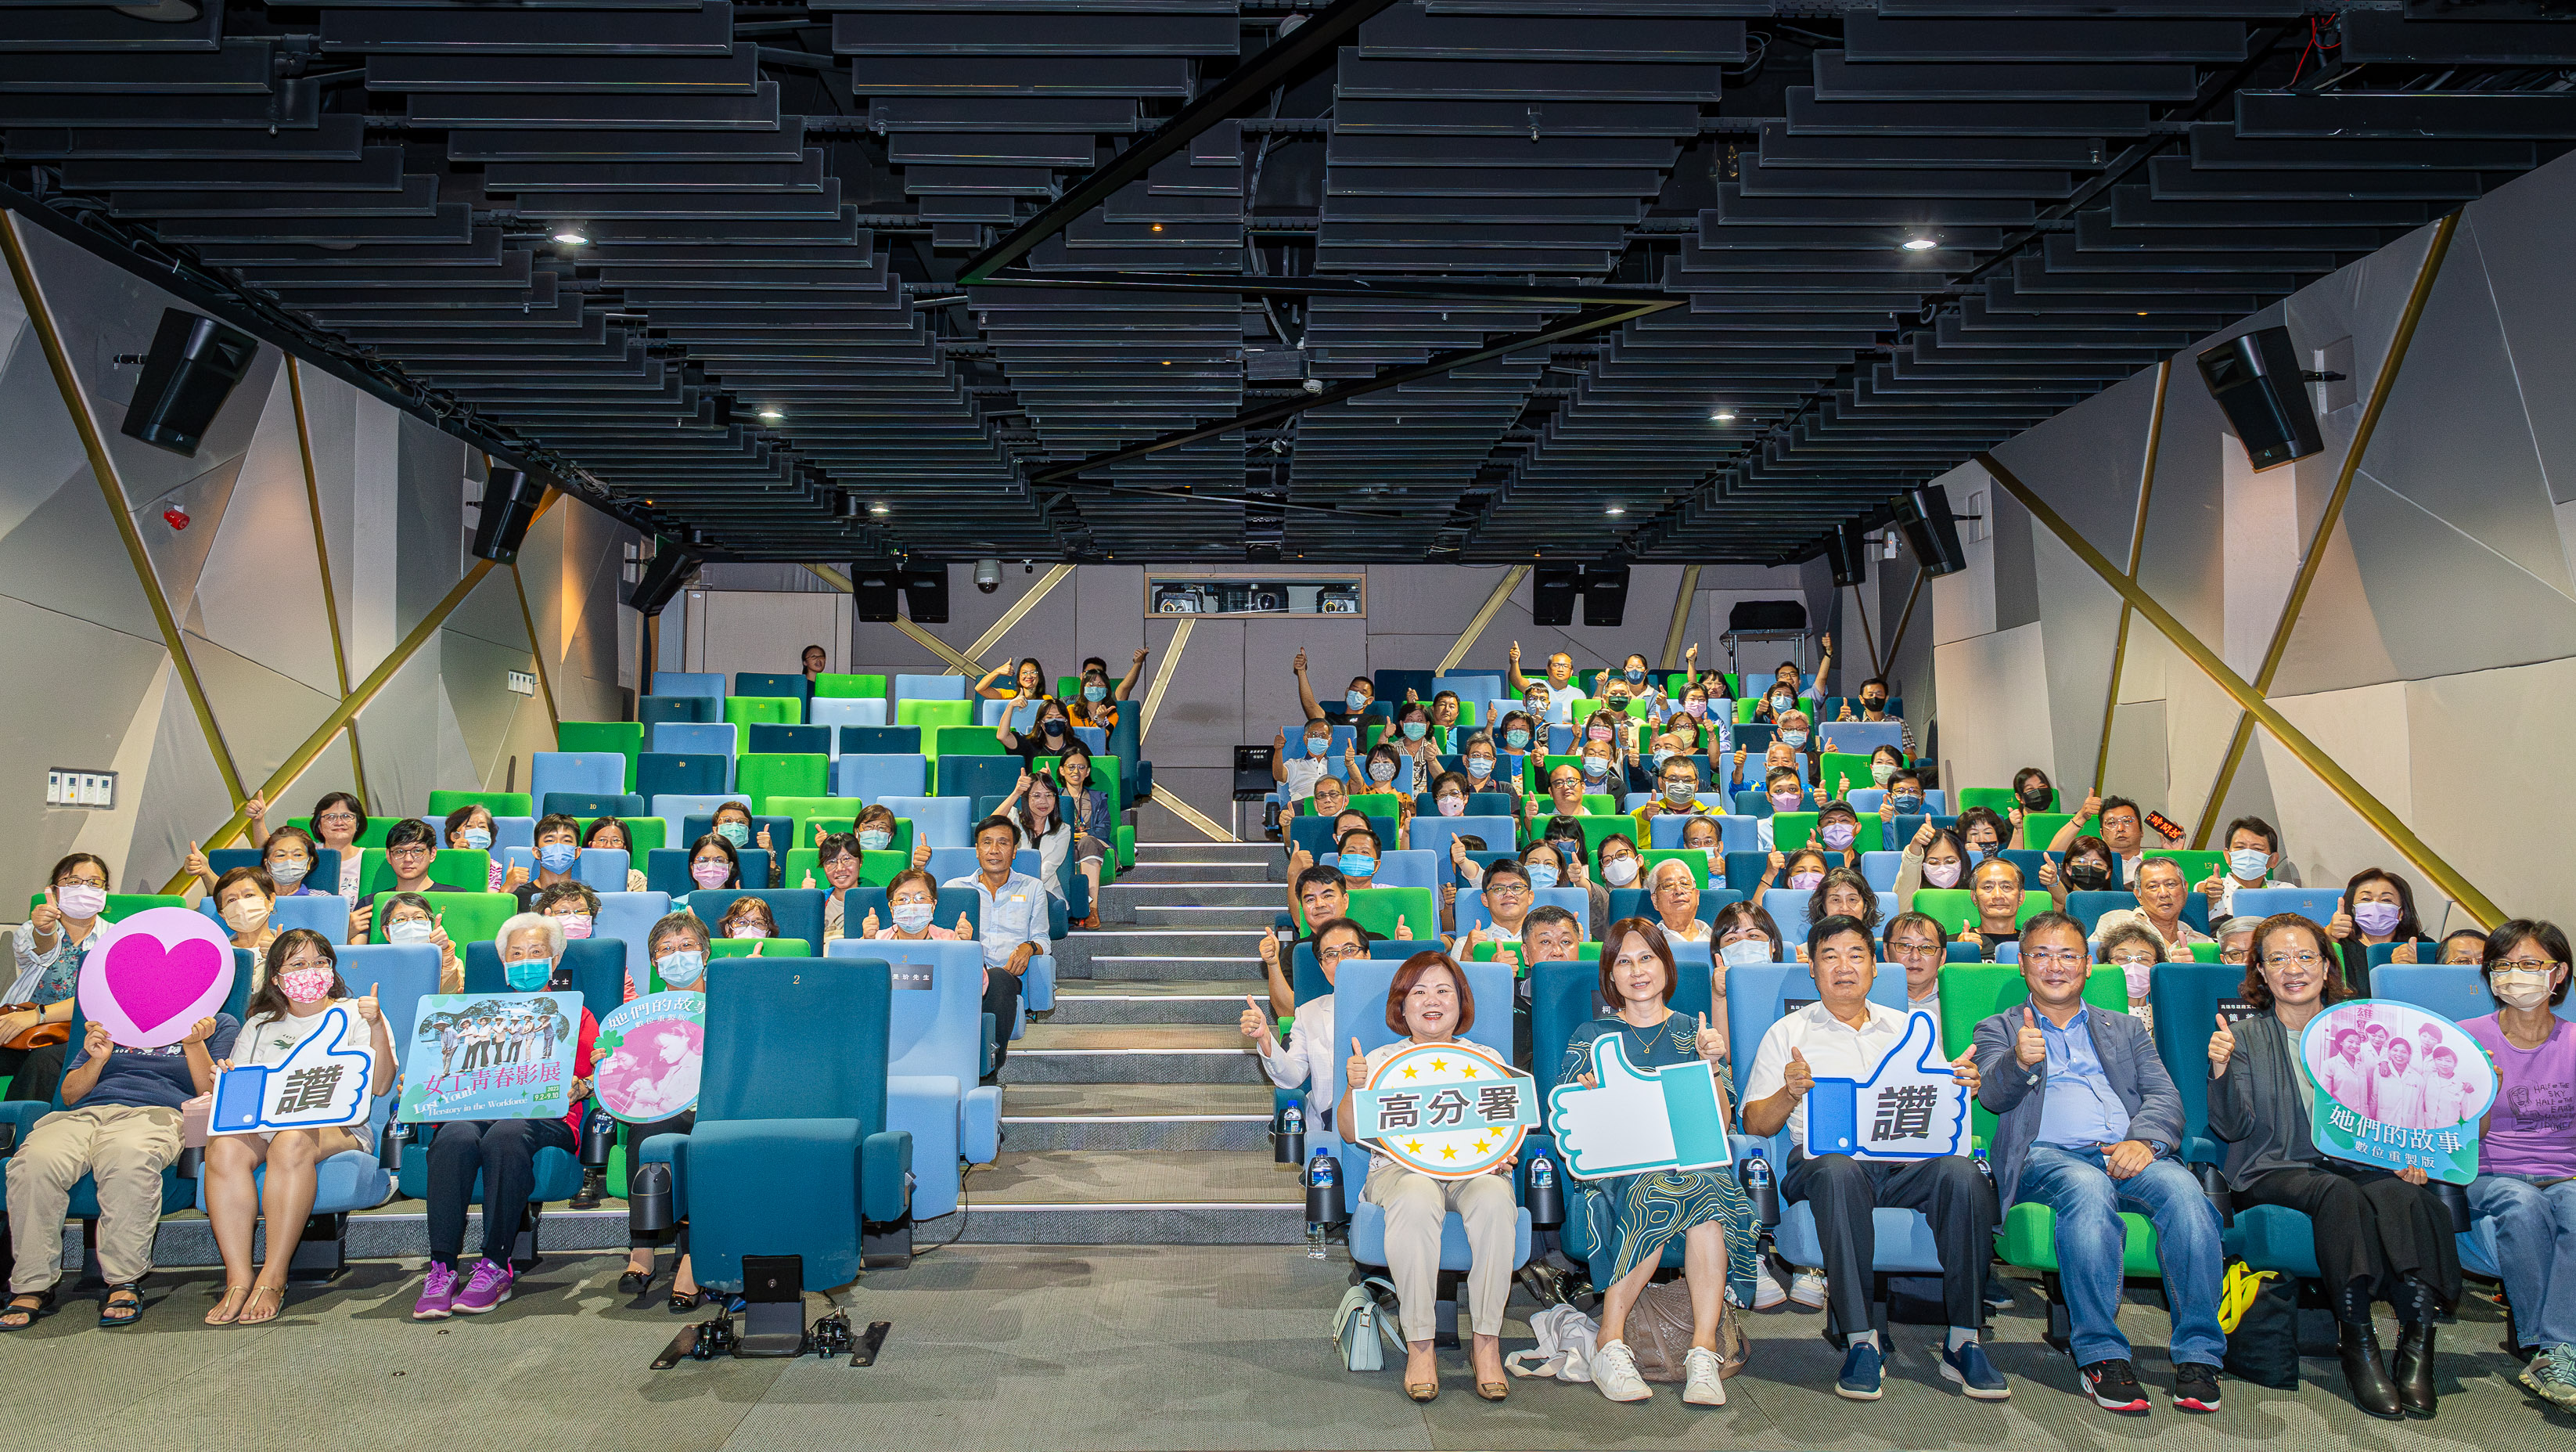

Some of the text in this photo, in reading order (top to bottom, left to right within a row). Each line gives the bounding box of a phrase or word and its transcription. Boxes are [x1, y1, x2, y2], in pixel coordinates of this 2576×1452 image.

[901, 954, 908, 963] 2
[793, 975, 801, 985] 2
[275, 1064, 344, 1115] 讚
[423, 1061, 561, 1097] 女工青春影展
[413, 1086, 477, 1115] Lost Youth
[429, 1104, 461, 1116] Herstory
[488, 1097, 528, 1108] Workforce
[534, 1092, 559, 1101] 9.2-9.10
[1378, 1086, 1520, 1130] 高分署
[1871, 1084, 1937, 1141] 讚
[2327, 1105, 2463, 1154] 她們的故事
[2355, 1140, 2435, 1169] 數位重製版
